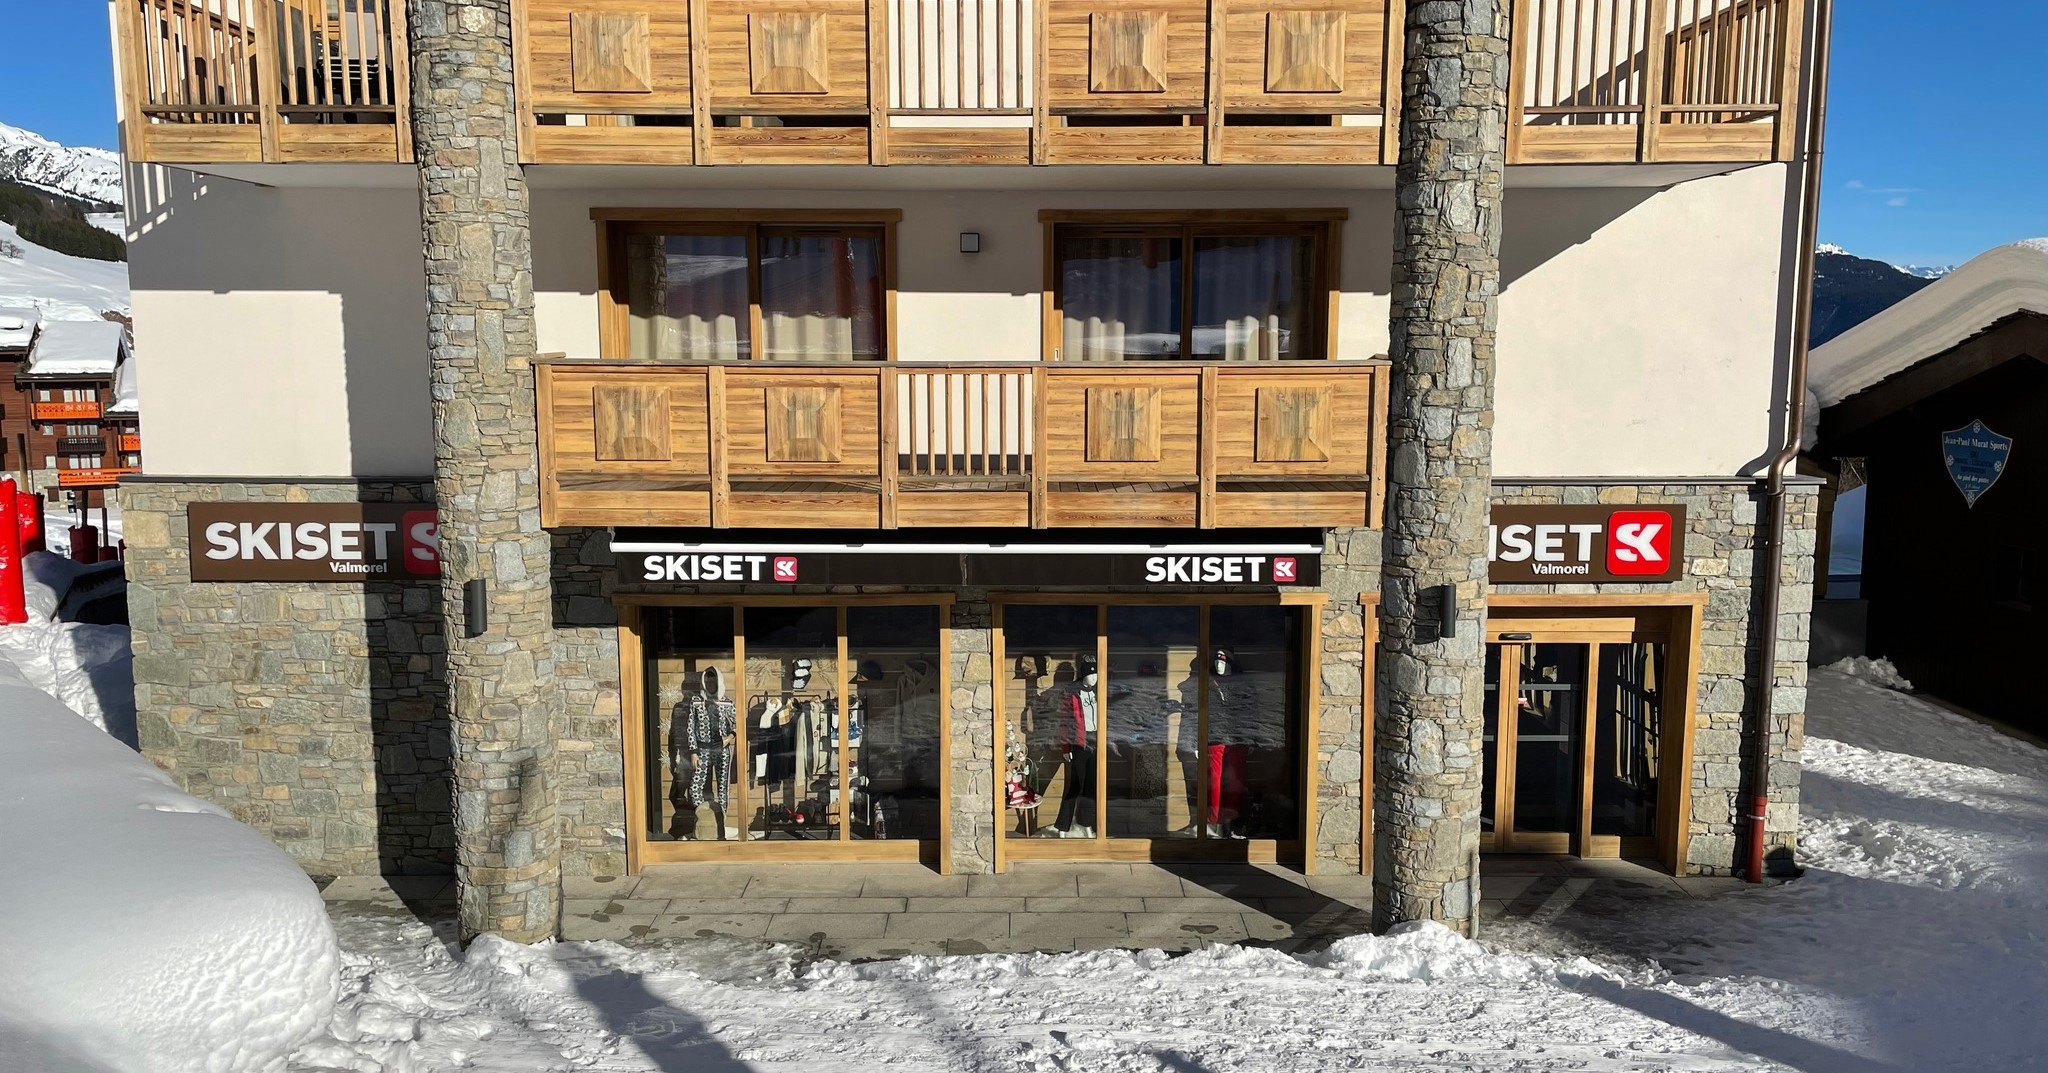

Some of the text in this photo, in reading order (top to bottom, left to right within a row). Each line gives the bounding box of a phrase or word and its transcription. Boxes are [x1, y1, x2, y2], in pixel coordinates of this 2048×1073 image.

[1990, 440, 2008, 451] Sports
[205, 521, 439, 560] SKISET S
[1489, 522, 1664, 562] ISET SK
[329, 562, 388, 574] Valmorel
[643, 554, 796, 581] SKISET SK
[1144, 556, 1295, 582] SKISET SK
[1531, 562, 1590, 576] Valmorel
